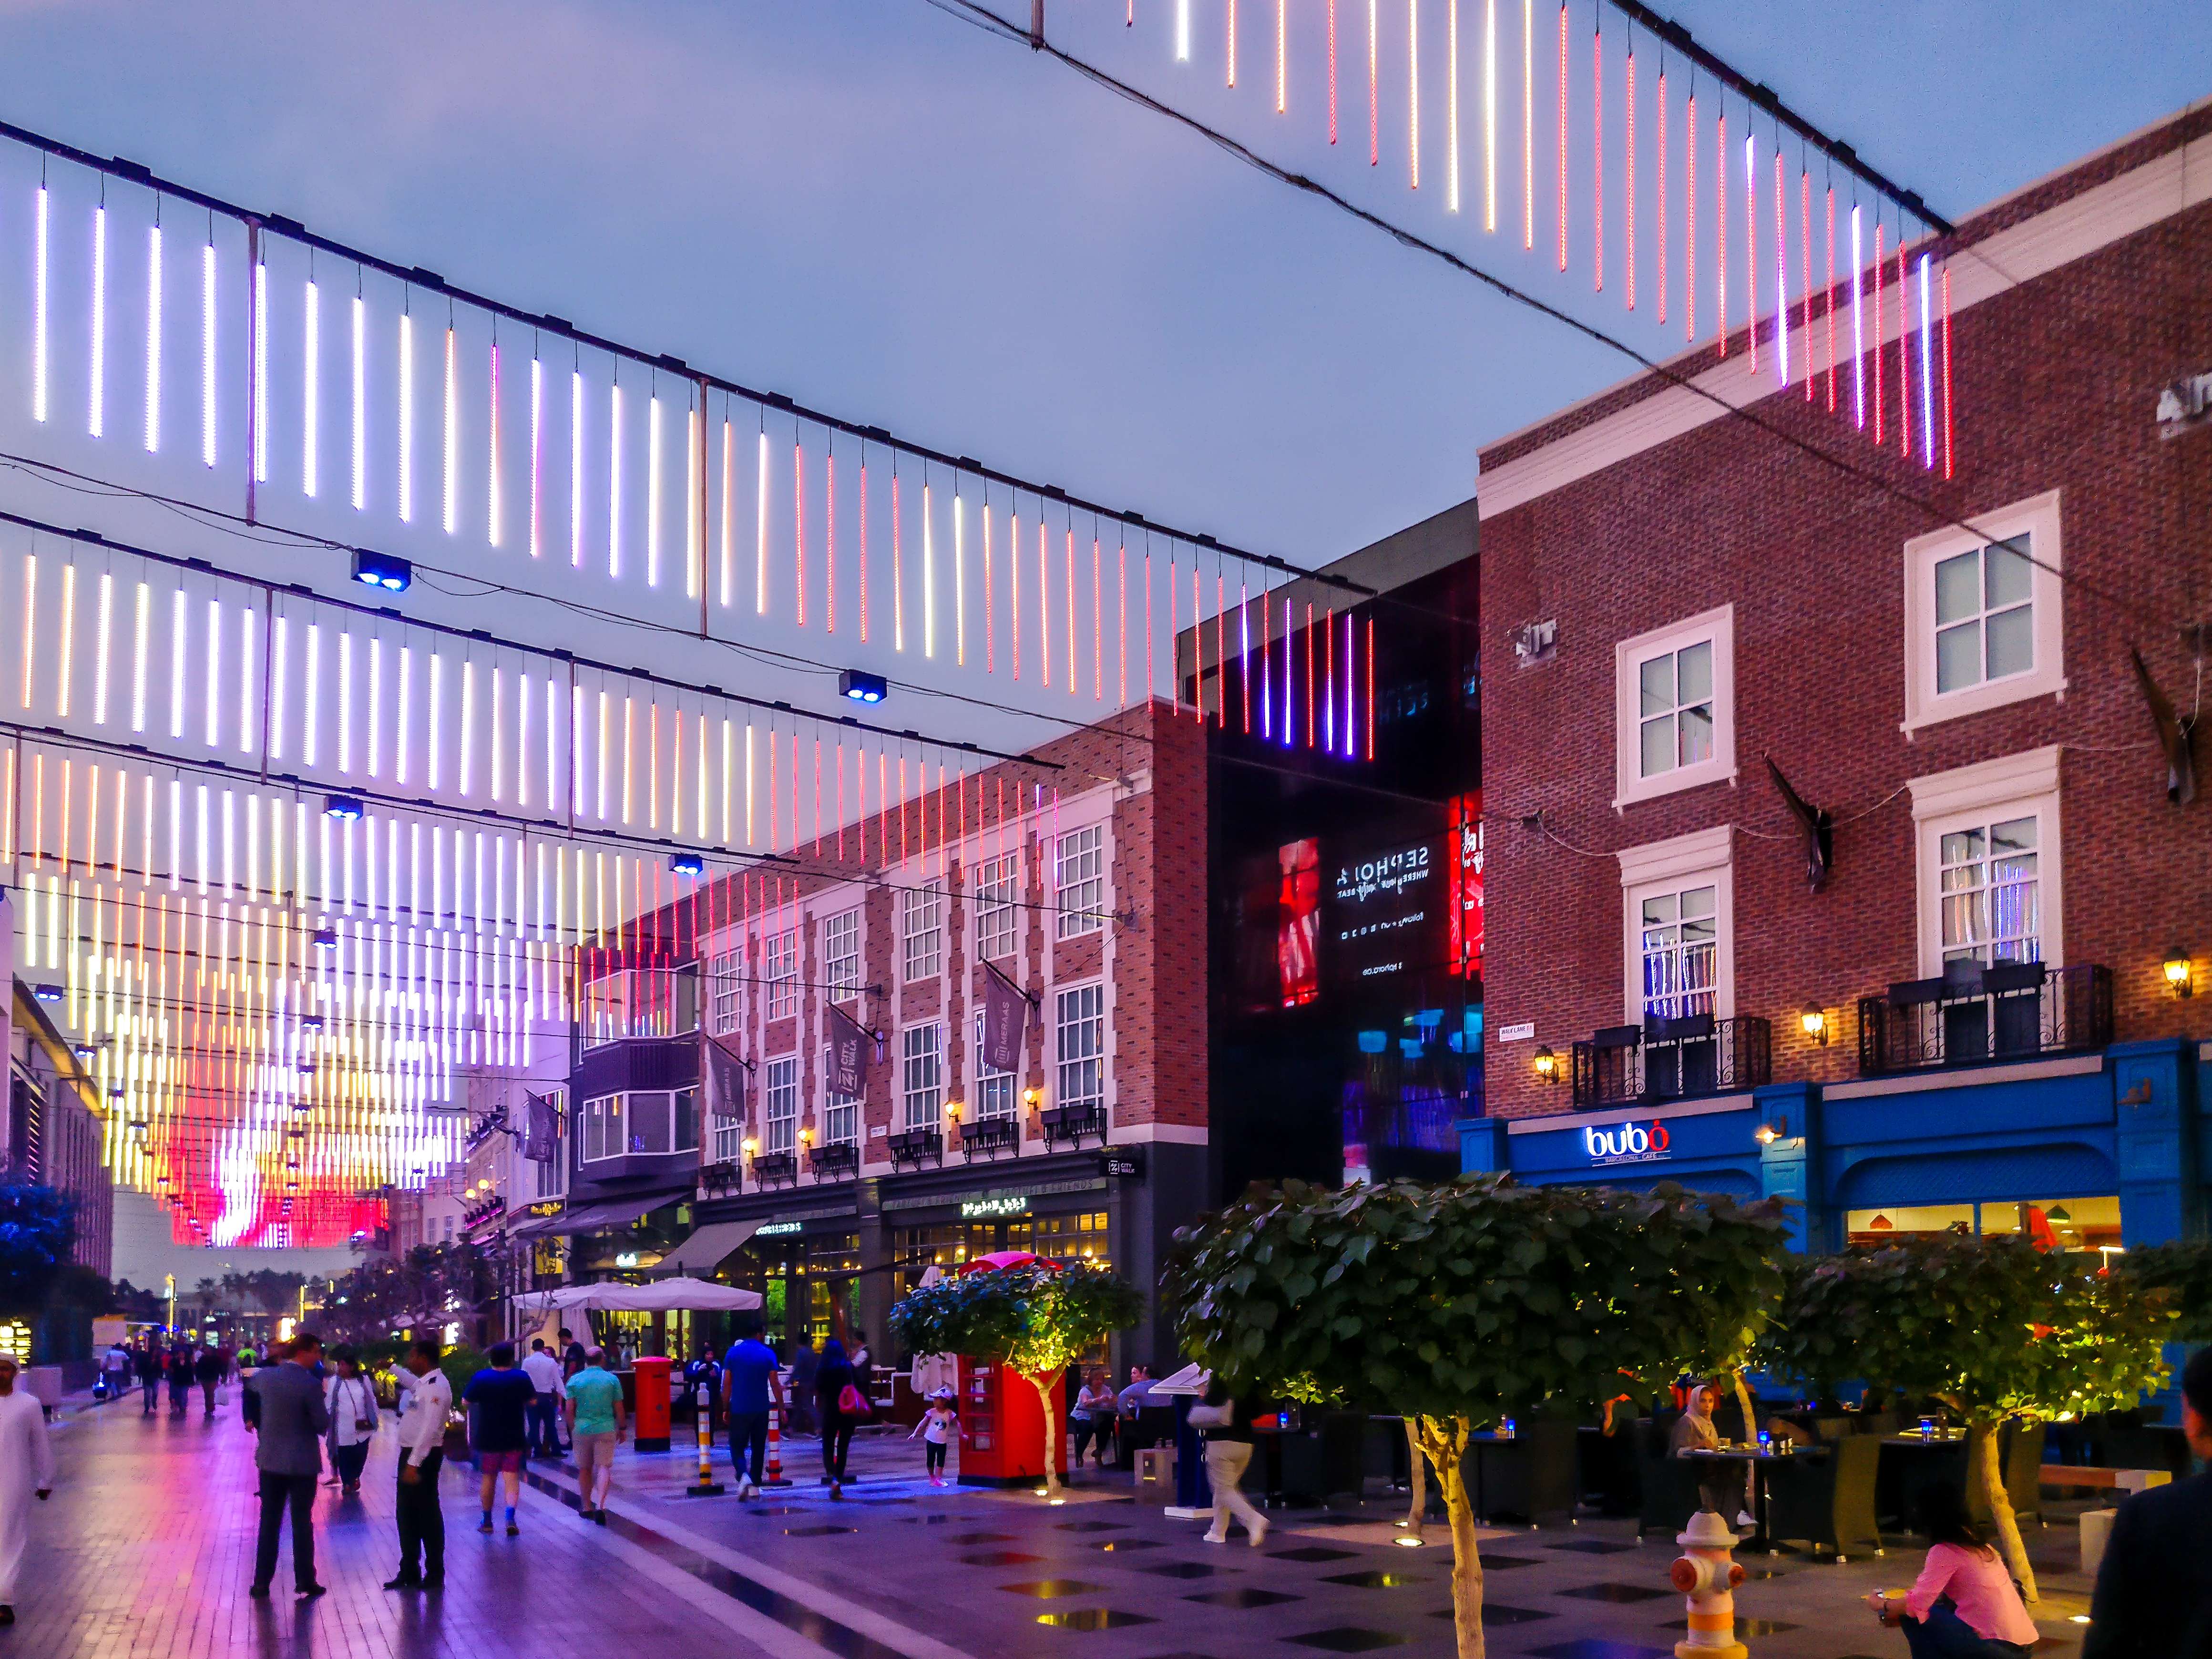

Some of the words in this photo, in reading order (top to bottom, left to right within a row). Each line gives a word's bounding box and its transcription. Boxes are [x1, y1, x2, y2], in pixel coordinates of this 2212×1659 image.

[1001, 1001, 1010, 1046] MERAAS
[840, 1042, 850, 1065] CITY
[848, 1039, 857, 1065] WALK
